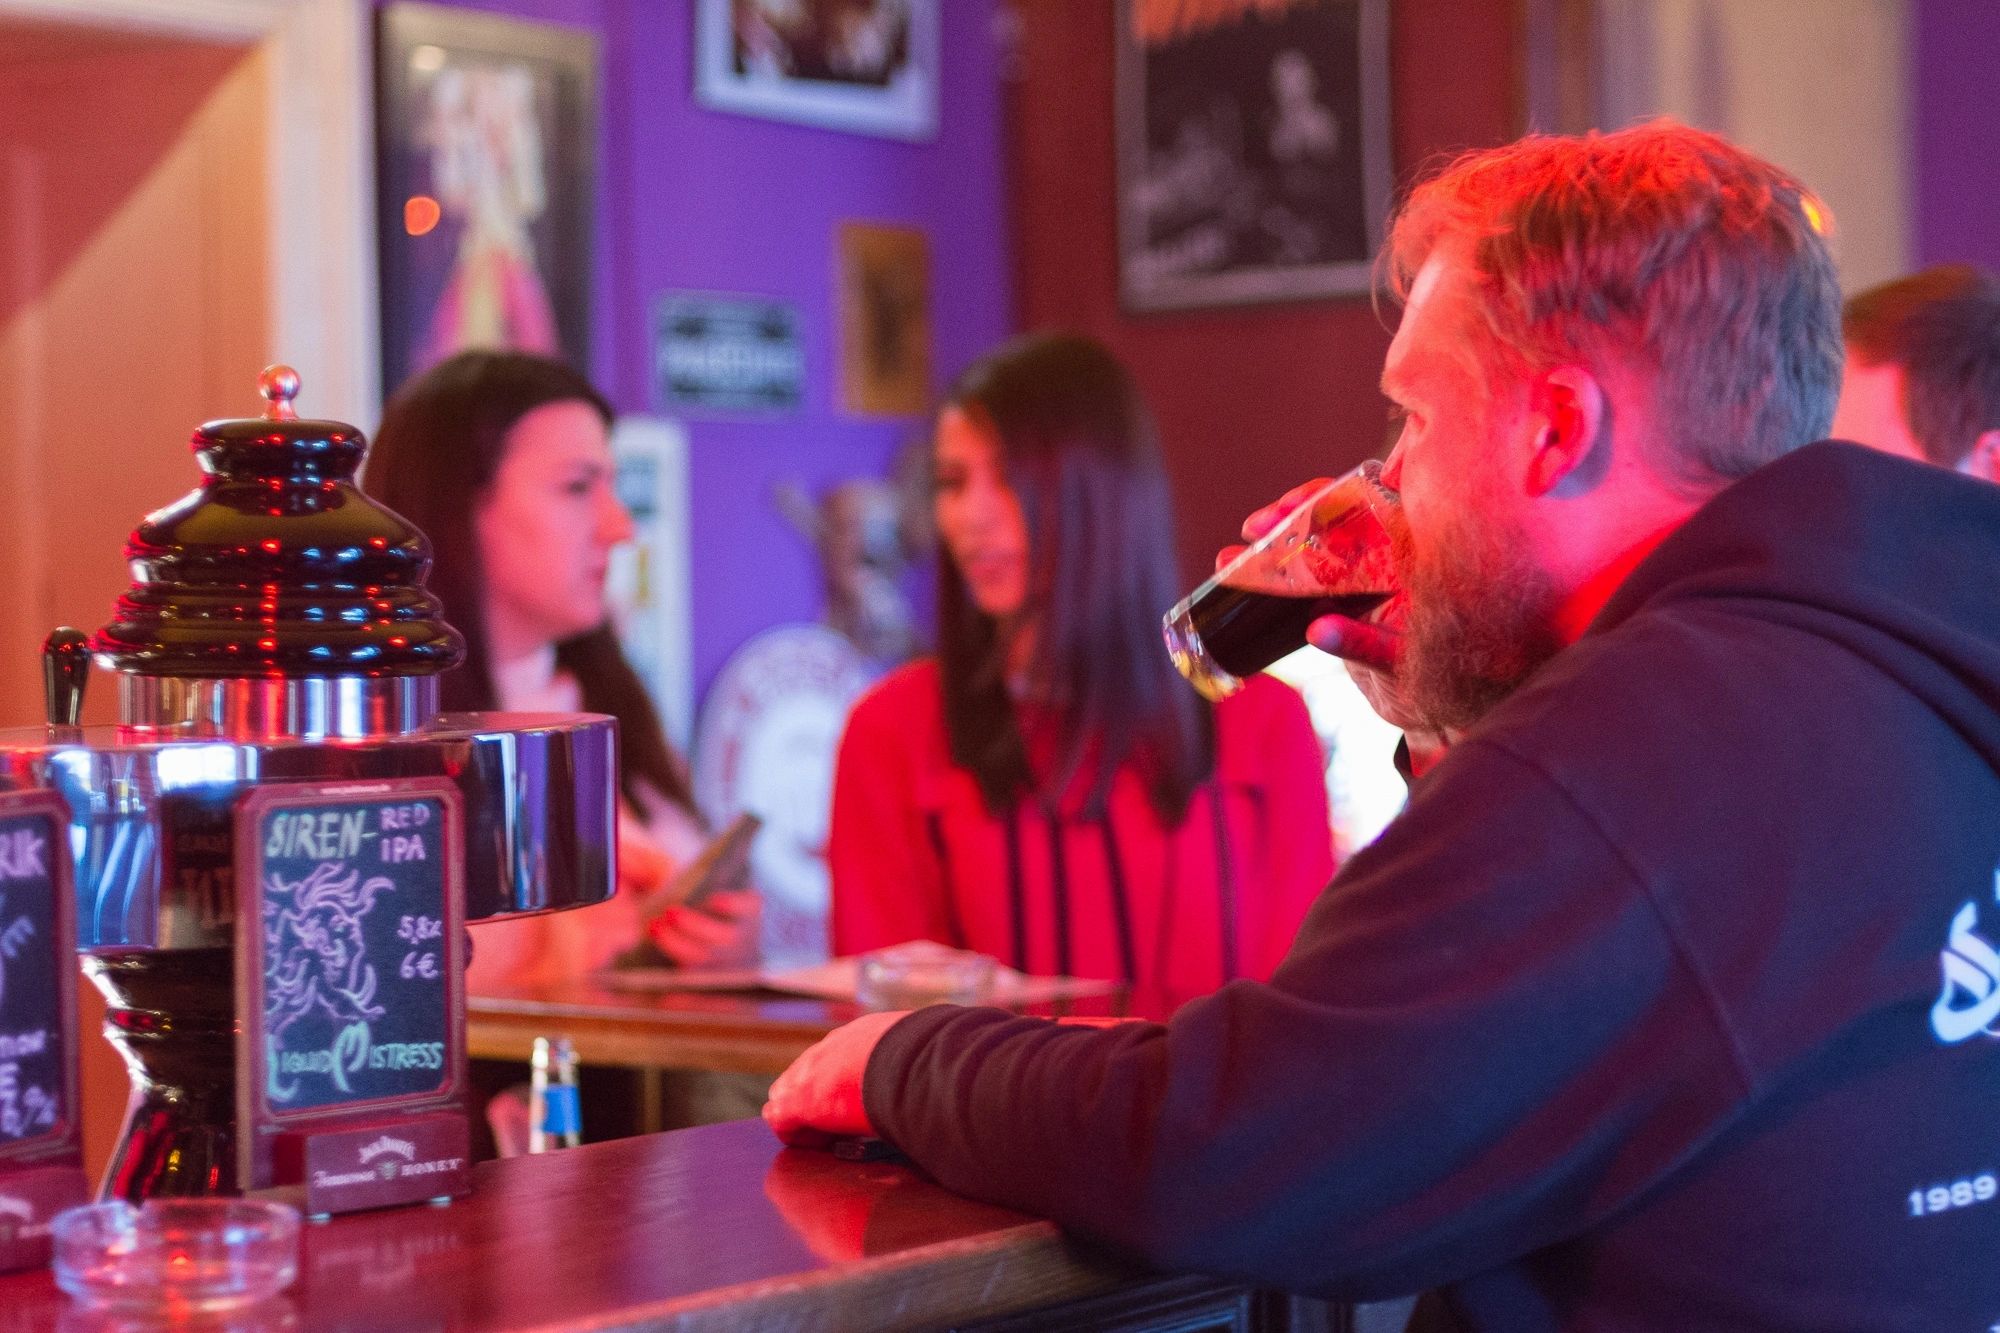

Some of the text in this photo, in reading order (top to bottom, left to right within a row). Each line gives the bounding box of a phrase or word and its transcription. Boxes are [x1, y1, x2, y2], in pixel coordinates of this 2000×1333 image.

[380, 802, 431, 830] RED
[380, 834, 427, 863] IPA
[400, 951, 440, 979] 6€
[1908, 1173, 1998, 1217] 1989
